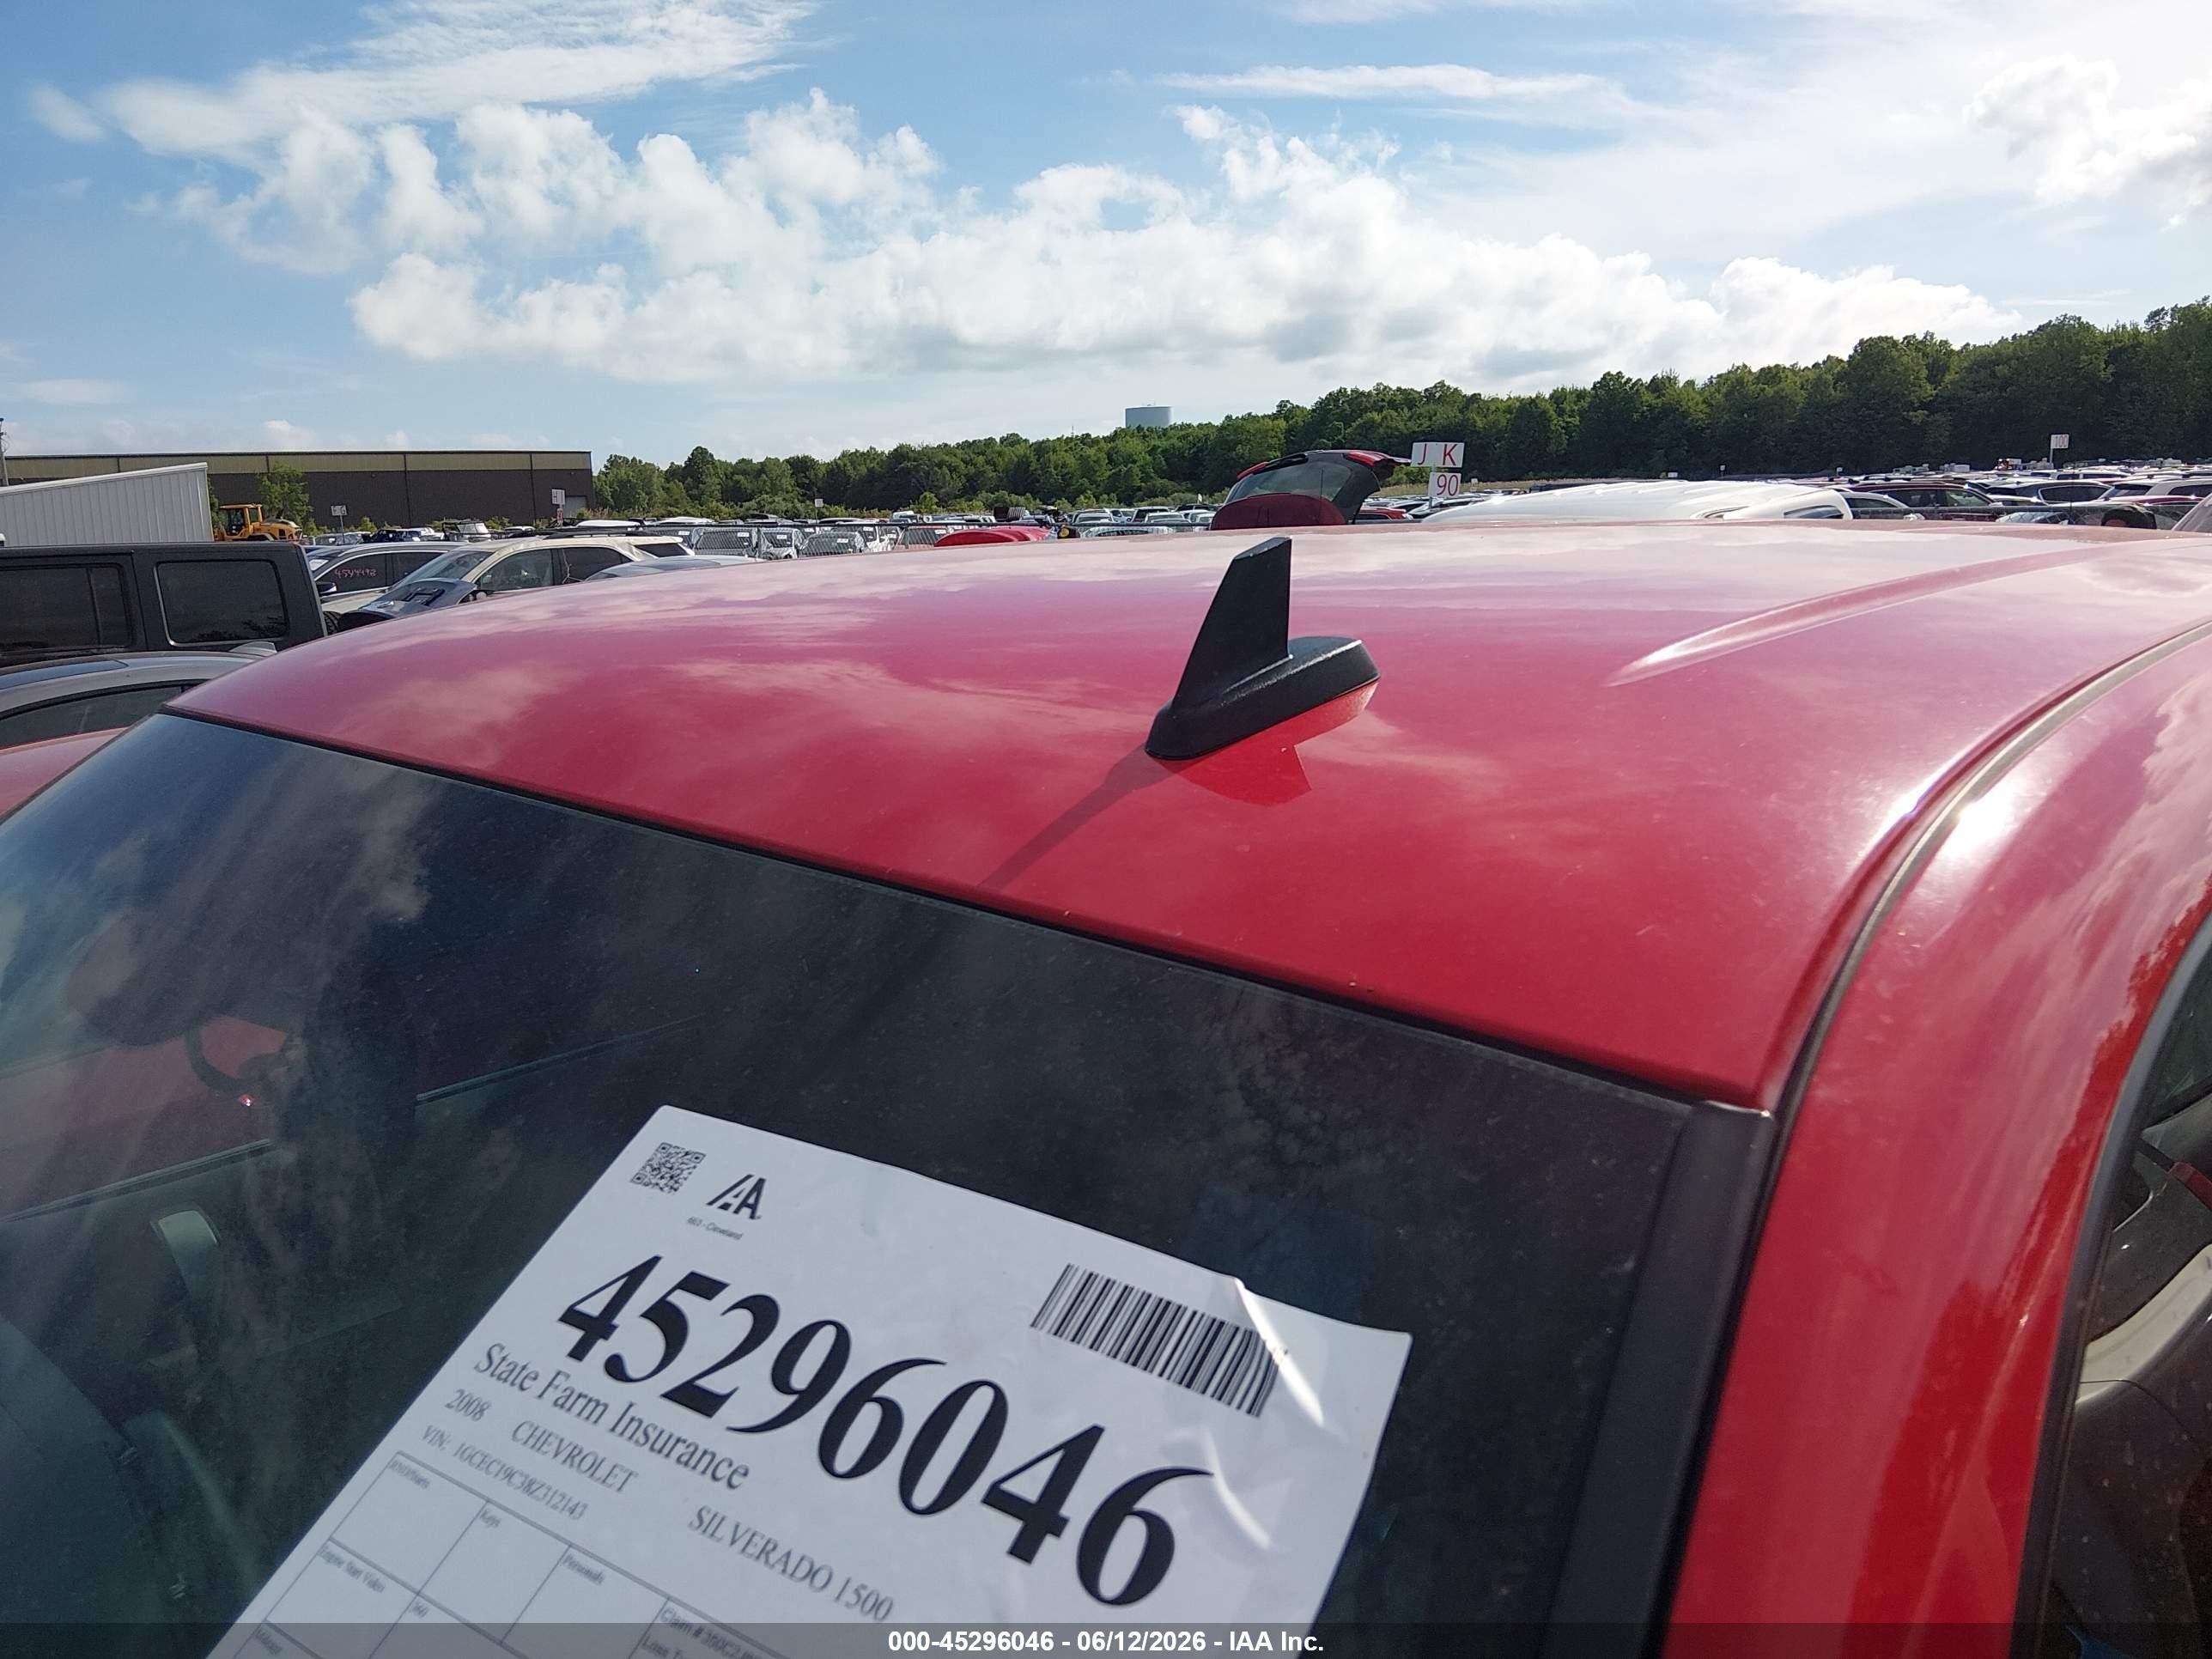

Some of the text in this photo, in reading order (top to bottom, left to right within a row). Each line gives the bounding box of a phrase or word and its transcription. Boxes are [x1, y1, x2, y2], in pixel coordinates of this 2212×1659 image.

[1417, 443, 1458, 466] J K
[1437, 474, 1459, 496] 90
[473, 1342, 750, 1491] State Farm Insurance
[422, 1425, 452, 1451] VIN:
[557, 1255, 1215, 1607] 45296046
[444, 1389, 895, 1624] 2008 CHEVROLET SILVERADO 1500
[659, 1607, 694, 1635] Claim
